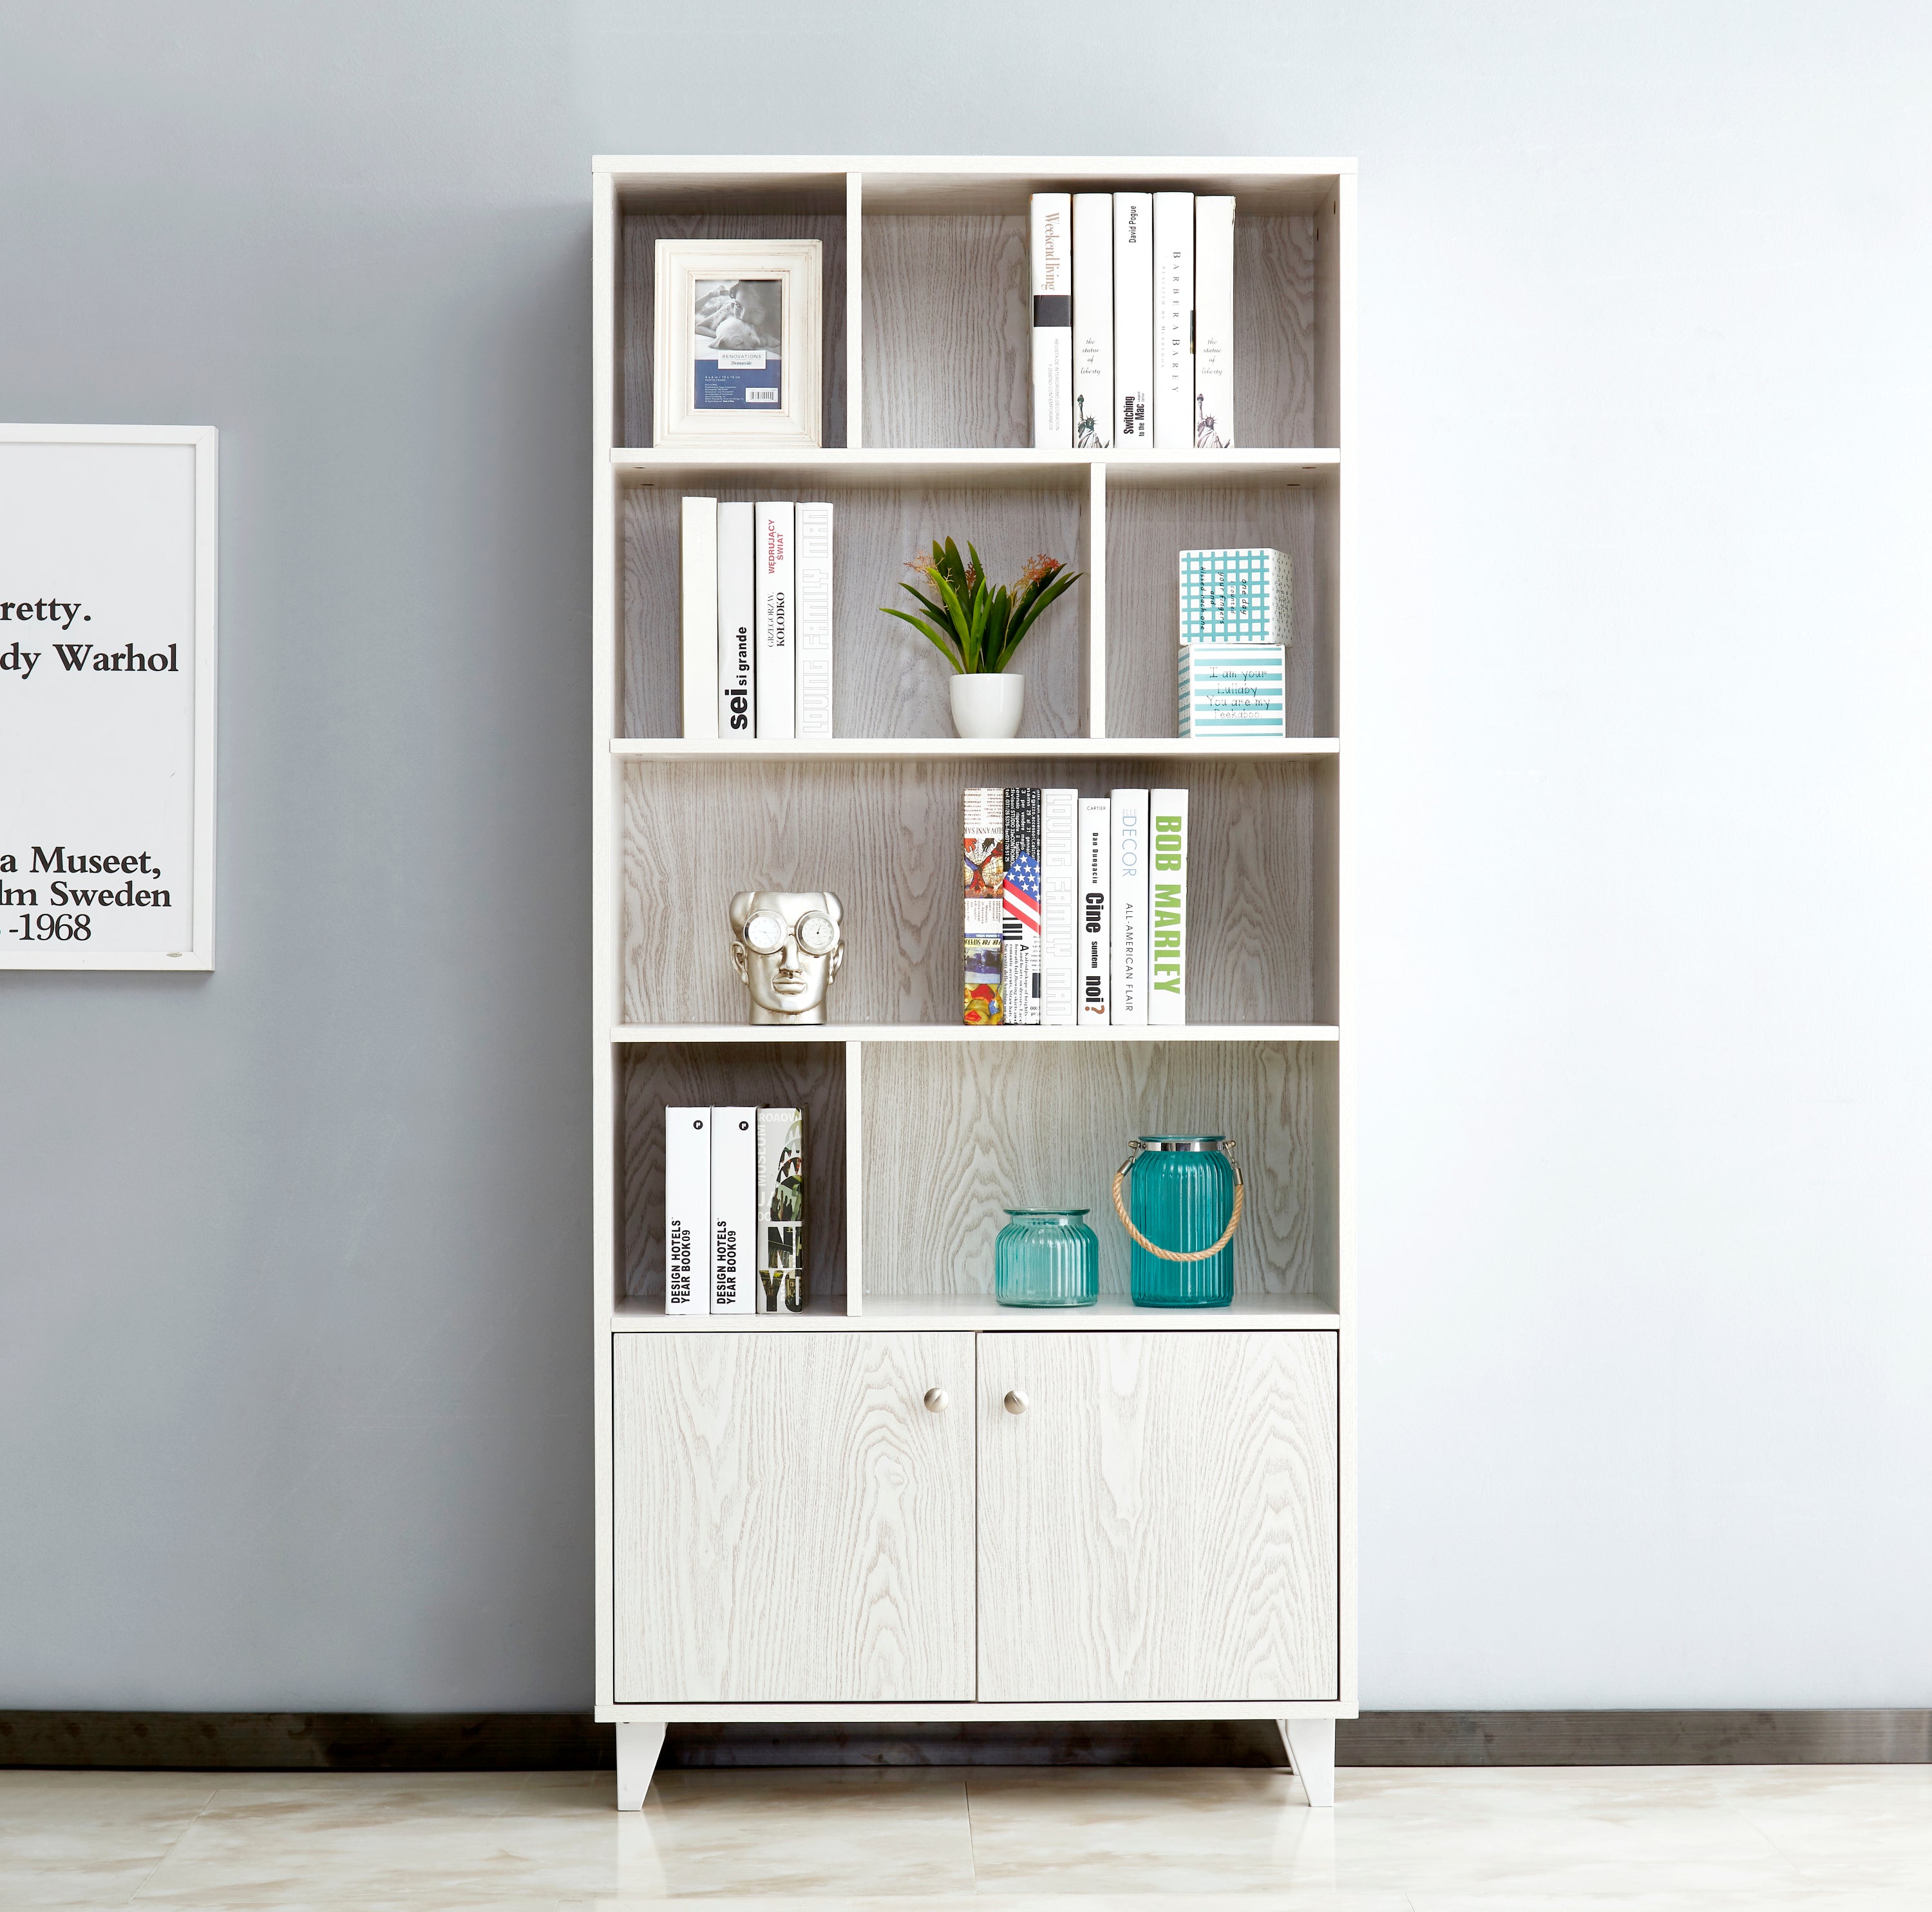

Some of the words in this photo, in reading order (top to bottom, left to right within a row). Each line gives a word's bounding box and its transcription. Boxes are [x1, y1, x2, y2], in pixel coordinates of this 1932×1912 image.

[1129, 206, 1137, 224] Pogue
[1045, 213, 1060, 259] Weekend
[1041, 260, 1060, 290] living
[1172, 252, 1181, 330] BARBERA
[1081, 367, 1101, 376] liberty
[1087, 355, 1094, 364] of
[1202, 367, 1222, 376] liberty
[1208, 355, 1216, 364] of
[1124, 397, 1135, 433] Switching
[1135, 404, 1144, 420] Mac
[0, 598, 91, 630] retty.
[1217, 595, 1226, 624] fingers
[1240, 599, 1249, 614] day
[0, 642, 41, 679] dy
[53, 643, 178, 671] Warhol
[736, 627, 750, 671] grande
[736, 676, 746, 685] si
[1209, 667, 1218, 677] I
[1242, 671, 1267, 681] your
[1207, 696, 1227, 706] You
[1255, 699, 1270, 710] my
[1217, 683, 1257, 697] Lullaby
[725, 690, 747, 730] sei
[1122, 817, 1137, 876] DECOR
[1155, 816, 1181, 871] BOB
[1, 855, 17, 872] a
[30, 847, 160, 881] Museet,
[51, 880, 171, 907] Sweden
[10, 914, 91, 941] -1968
[1086, 893, 1104, 932] Cine
[1154, 884, 1180, 994] MARLEY
[681, 1230, 690, 1271] BOOK09
[727, 1231, 736, 1272] BOOK09
[671, 1265, 680, 1303] DESIGN
[681, 1276, 690, 1303] YEAR
[717, 1266, 726, 1303] DESIGN
[726, 1277, 735, 1304] YEAR
